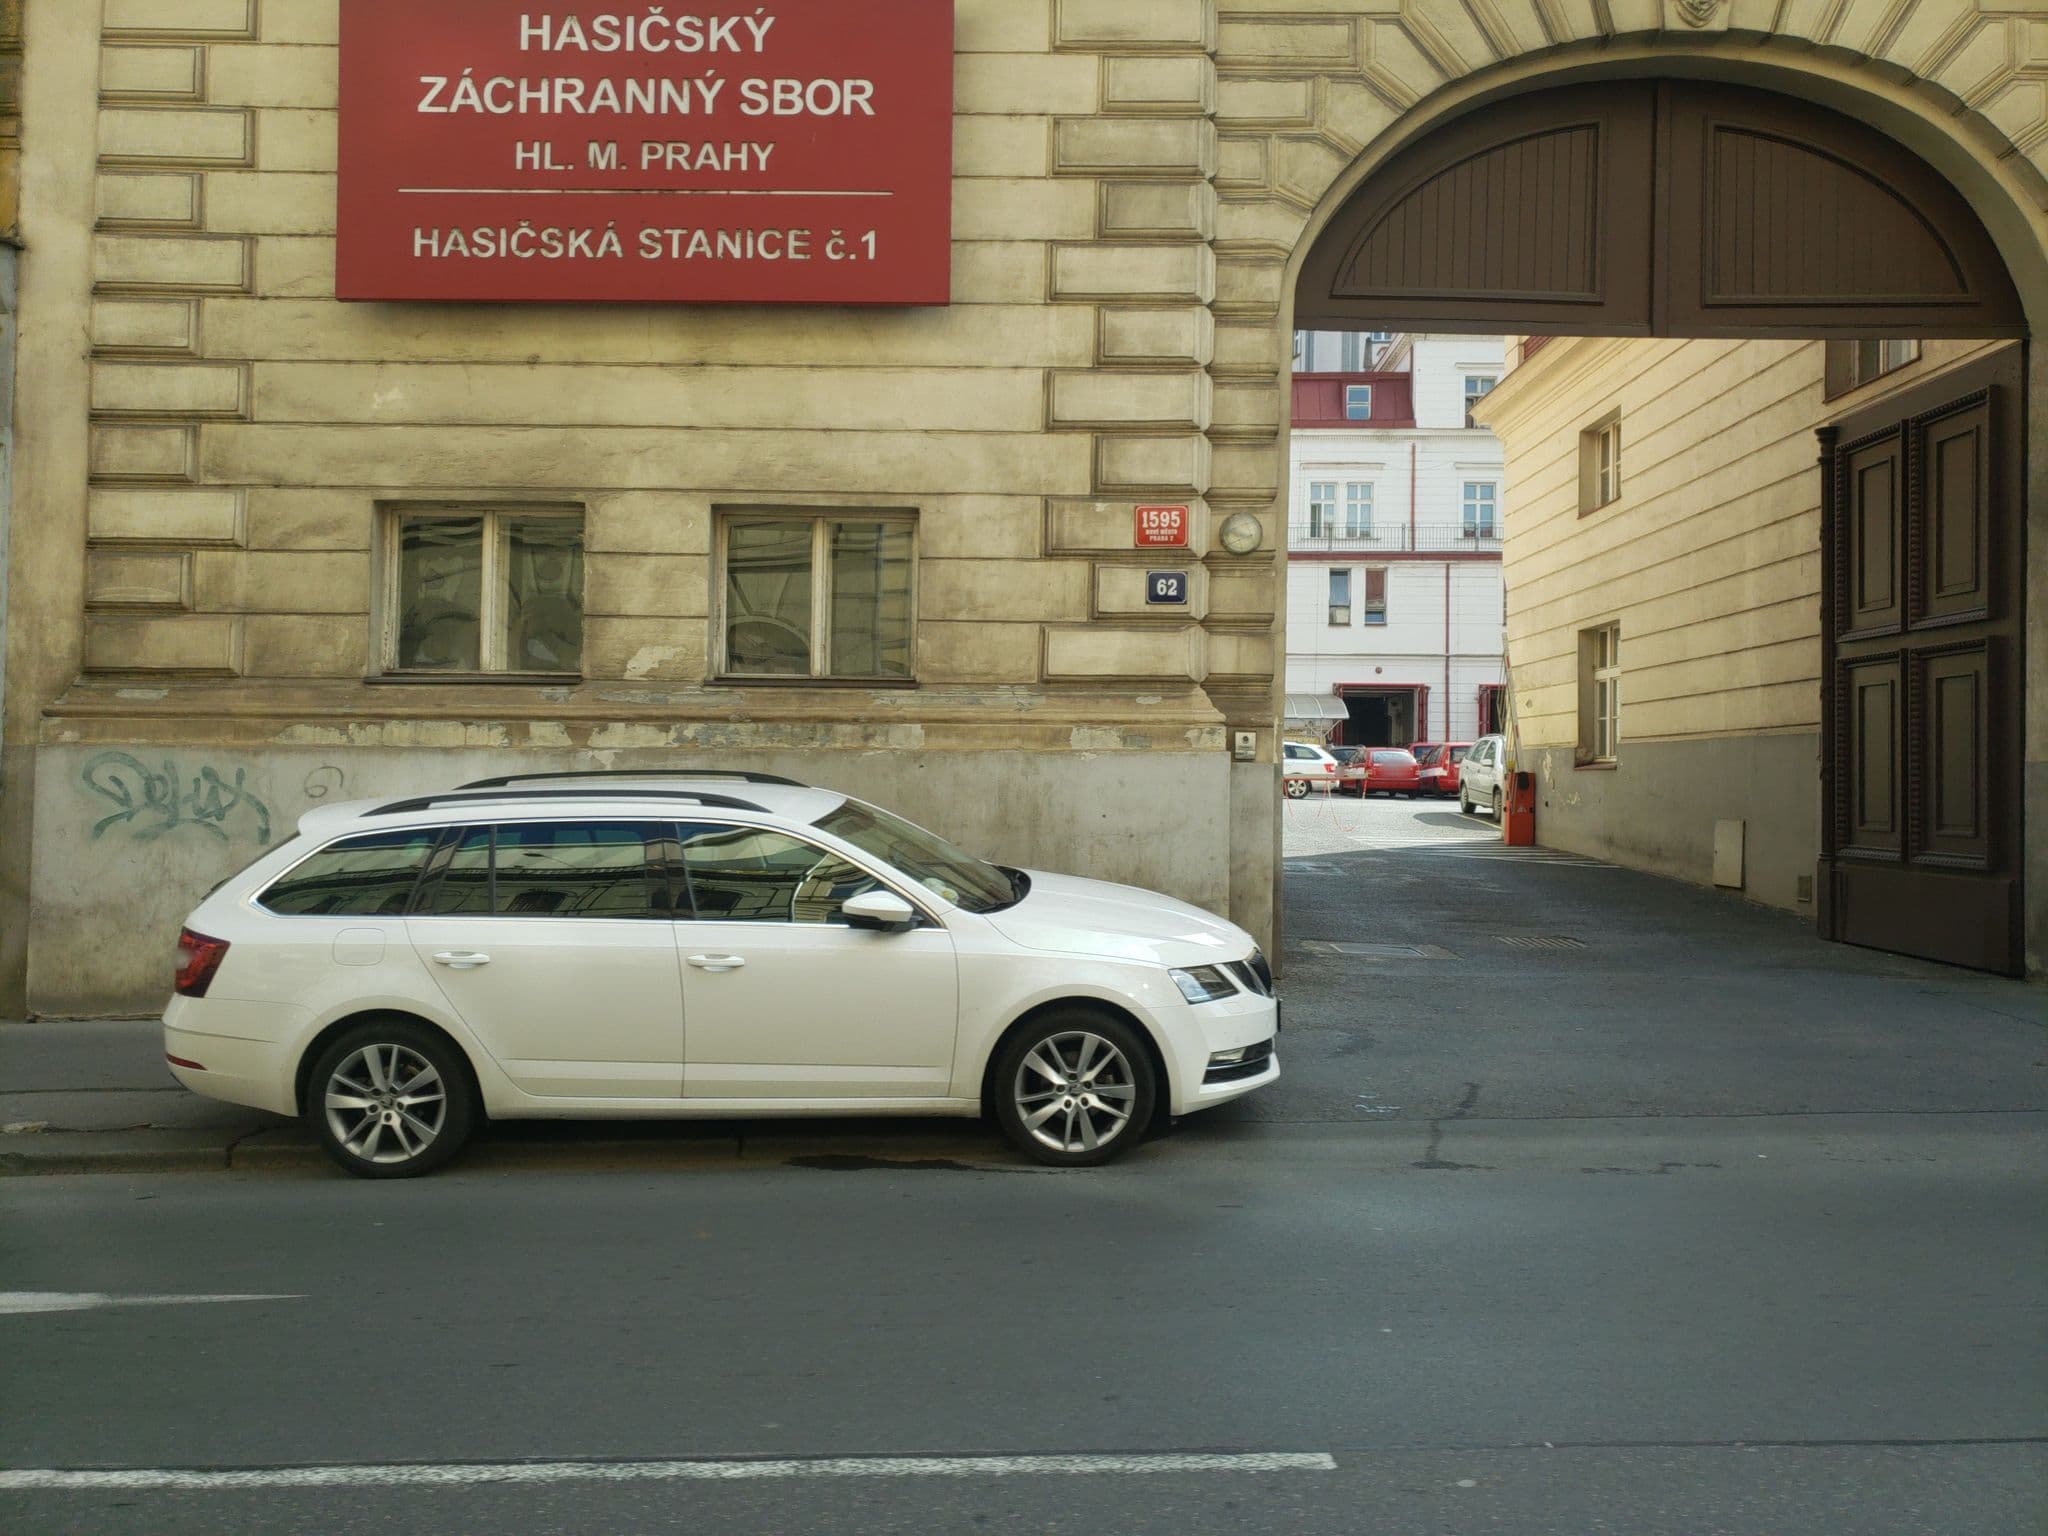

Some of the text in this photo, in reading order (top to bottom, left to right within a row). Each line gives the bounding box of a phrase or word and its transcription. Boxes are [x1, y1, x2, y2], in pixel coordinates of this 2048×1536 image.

[519, 7, 776, 53] HASIČSKÝ
[417, 68, 875, 116] ZÁCHRANNÝ SBOR
[515, 142, 774, 172] HL. M. PRAHY
[413, 221, 876, 261] HASIČSKÁ STANICE č.1
[1142, 511, 1181, 528] 1595
[1156, 578, 1178, 596] 62
